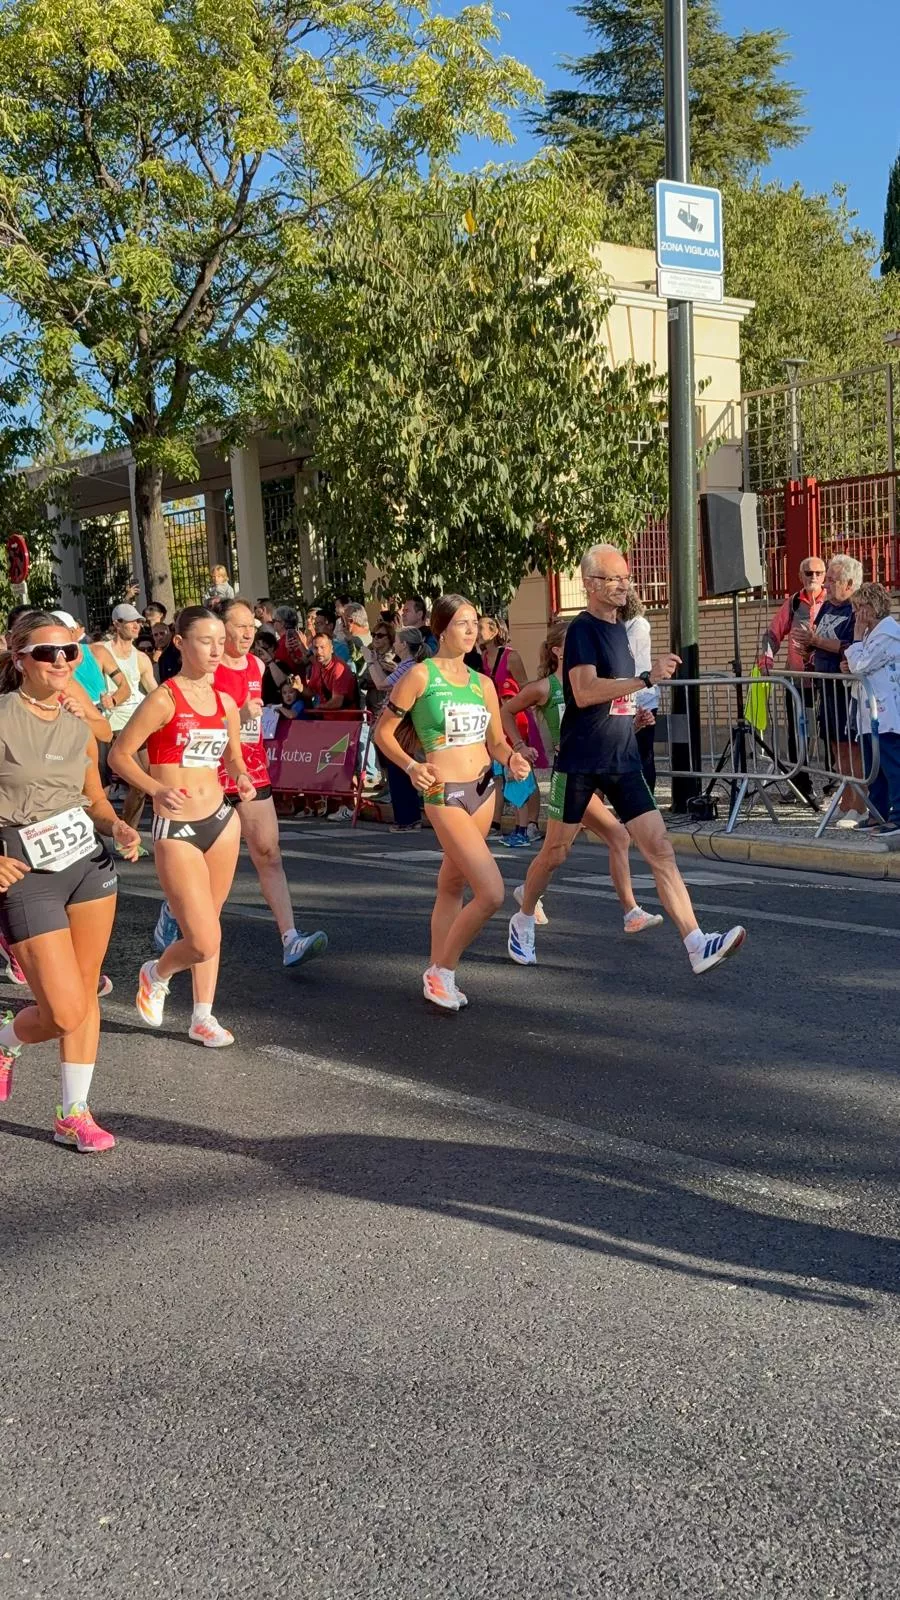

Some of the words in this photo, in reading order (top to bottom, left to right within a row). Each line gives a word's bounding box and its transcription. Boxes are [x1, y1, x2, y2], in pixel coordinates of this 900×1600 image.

[661, 241, 683, 253] ZONA
[684, 244, 720, 258] VIGILADA
[451, 714, 487, 733] 1578
[280, 748, 312, 762] kutxa
[34, 821, 88, 859] 1552
